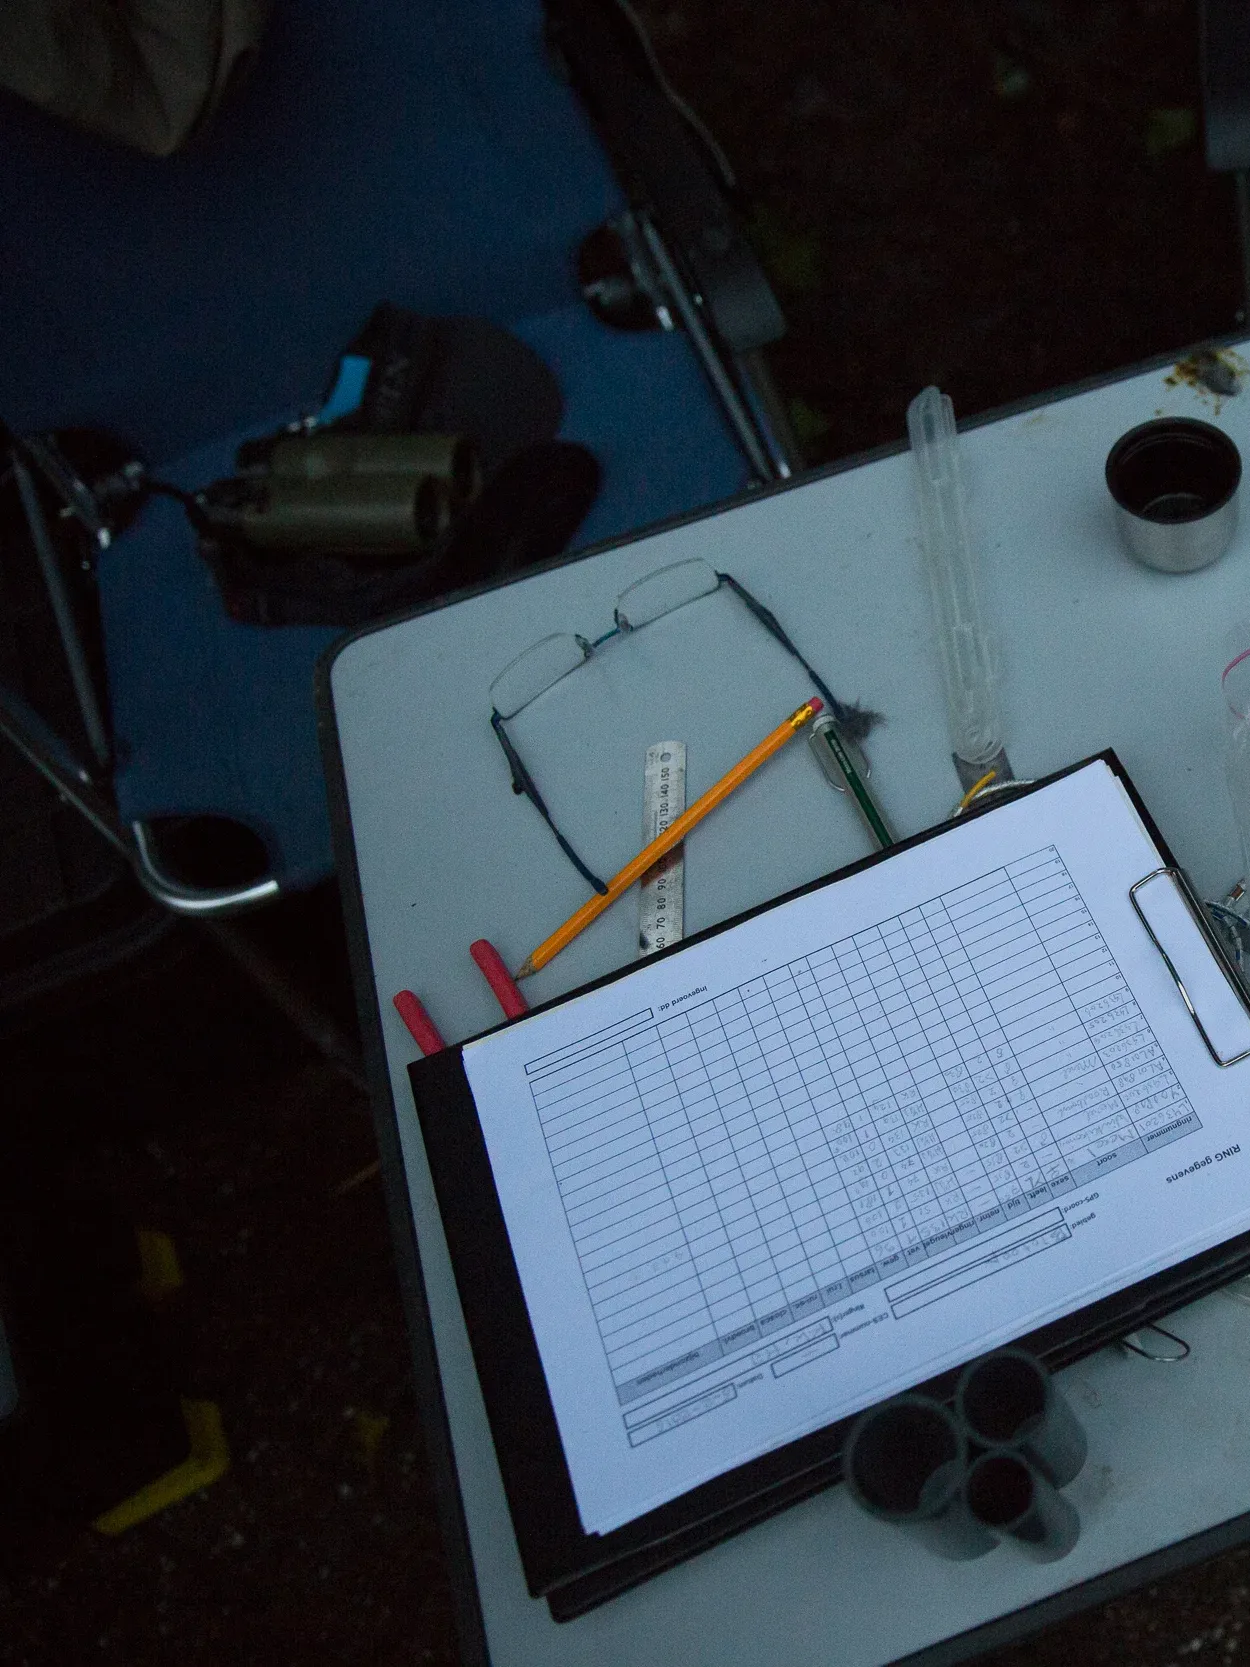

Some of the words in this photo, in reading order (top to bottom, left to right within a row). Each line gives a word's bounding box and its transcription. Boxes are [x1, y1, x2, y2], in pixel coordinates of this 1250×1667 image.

[660, 767, 669, 780] 150
[660, 783, 669, 797] 140
[660, 802, 668, 816] 130
[657, 878, 666, 890] 90
[656, 897, 666, 909] 80
[656, 917, 665, 928] 70
[656, 937, 665, 948] 60
[657, 1002, 670, 1011] dd:
[1144, 1115, 1194, 1143] ringnummer
[1094, 1151, 1118, 1167] soort
[1213, 1143, 1241, 1162] RING
[1165, 1154, 1212, 1183] gegevens
[1048, 1174, 1070, 1189] sexe
[1005, 1196, 1022, 1211] tijd
[905, 1244, 921, 1256] vet
